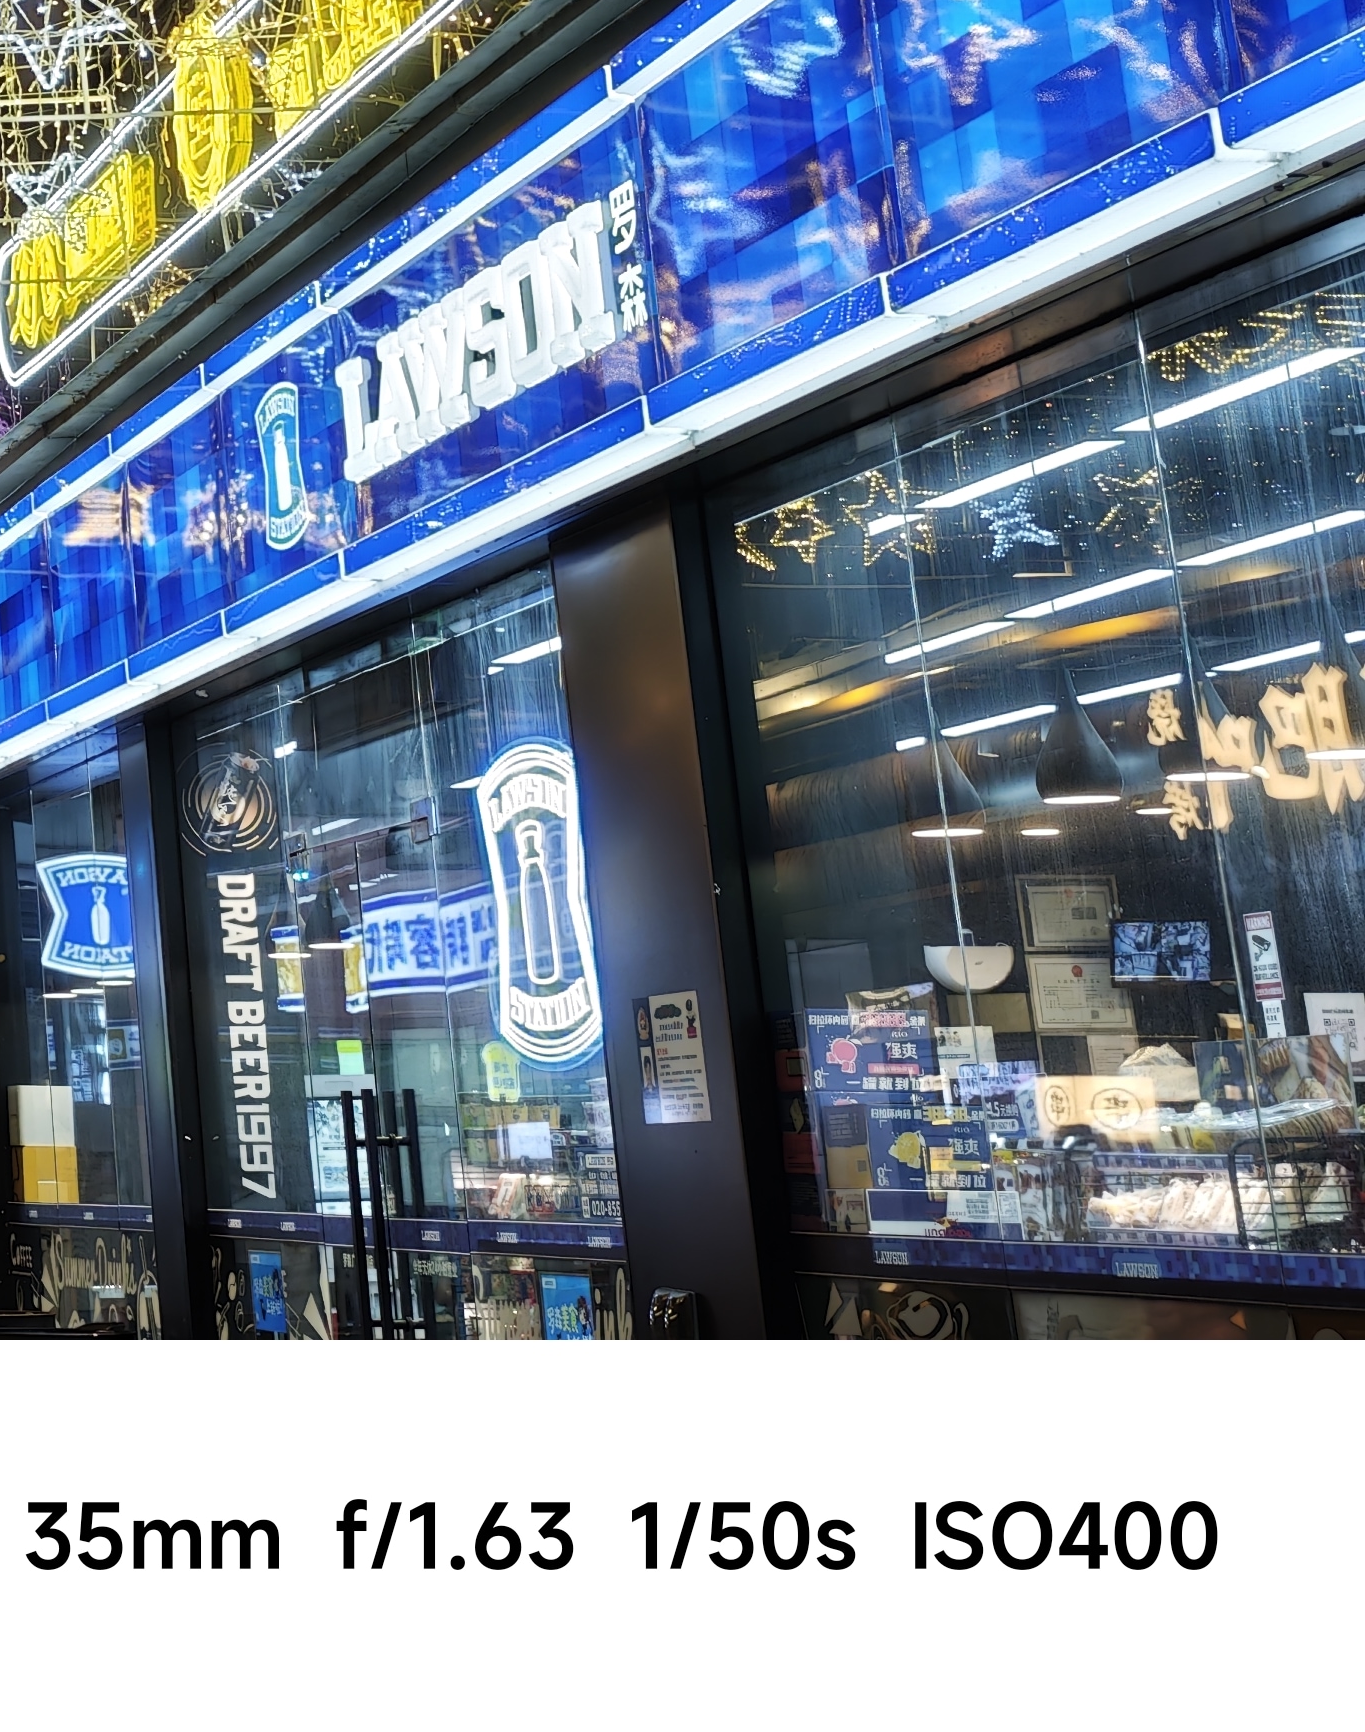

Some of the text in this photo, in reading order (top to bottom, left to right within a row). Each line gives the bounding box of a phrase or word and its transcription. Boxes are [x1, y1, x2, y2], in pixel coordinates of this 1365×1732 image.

[609, 180, 649, 333] 罗森
[335, 199, 616, 484] LAWSON
[259, 389, 296, 435] LAWSON
[488, 773, 566, 833] LAWSON
[217, 872, 263, 993] DRAFT
[509, 976, 592, 1032] STATION
[885, 1042, 918, 1060] 强爽
[874, 1250, 909, 1265] LAWSON
[1115, 1262, 1159, 1280] LAWSON
